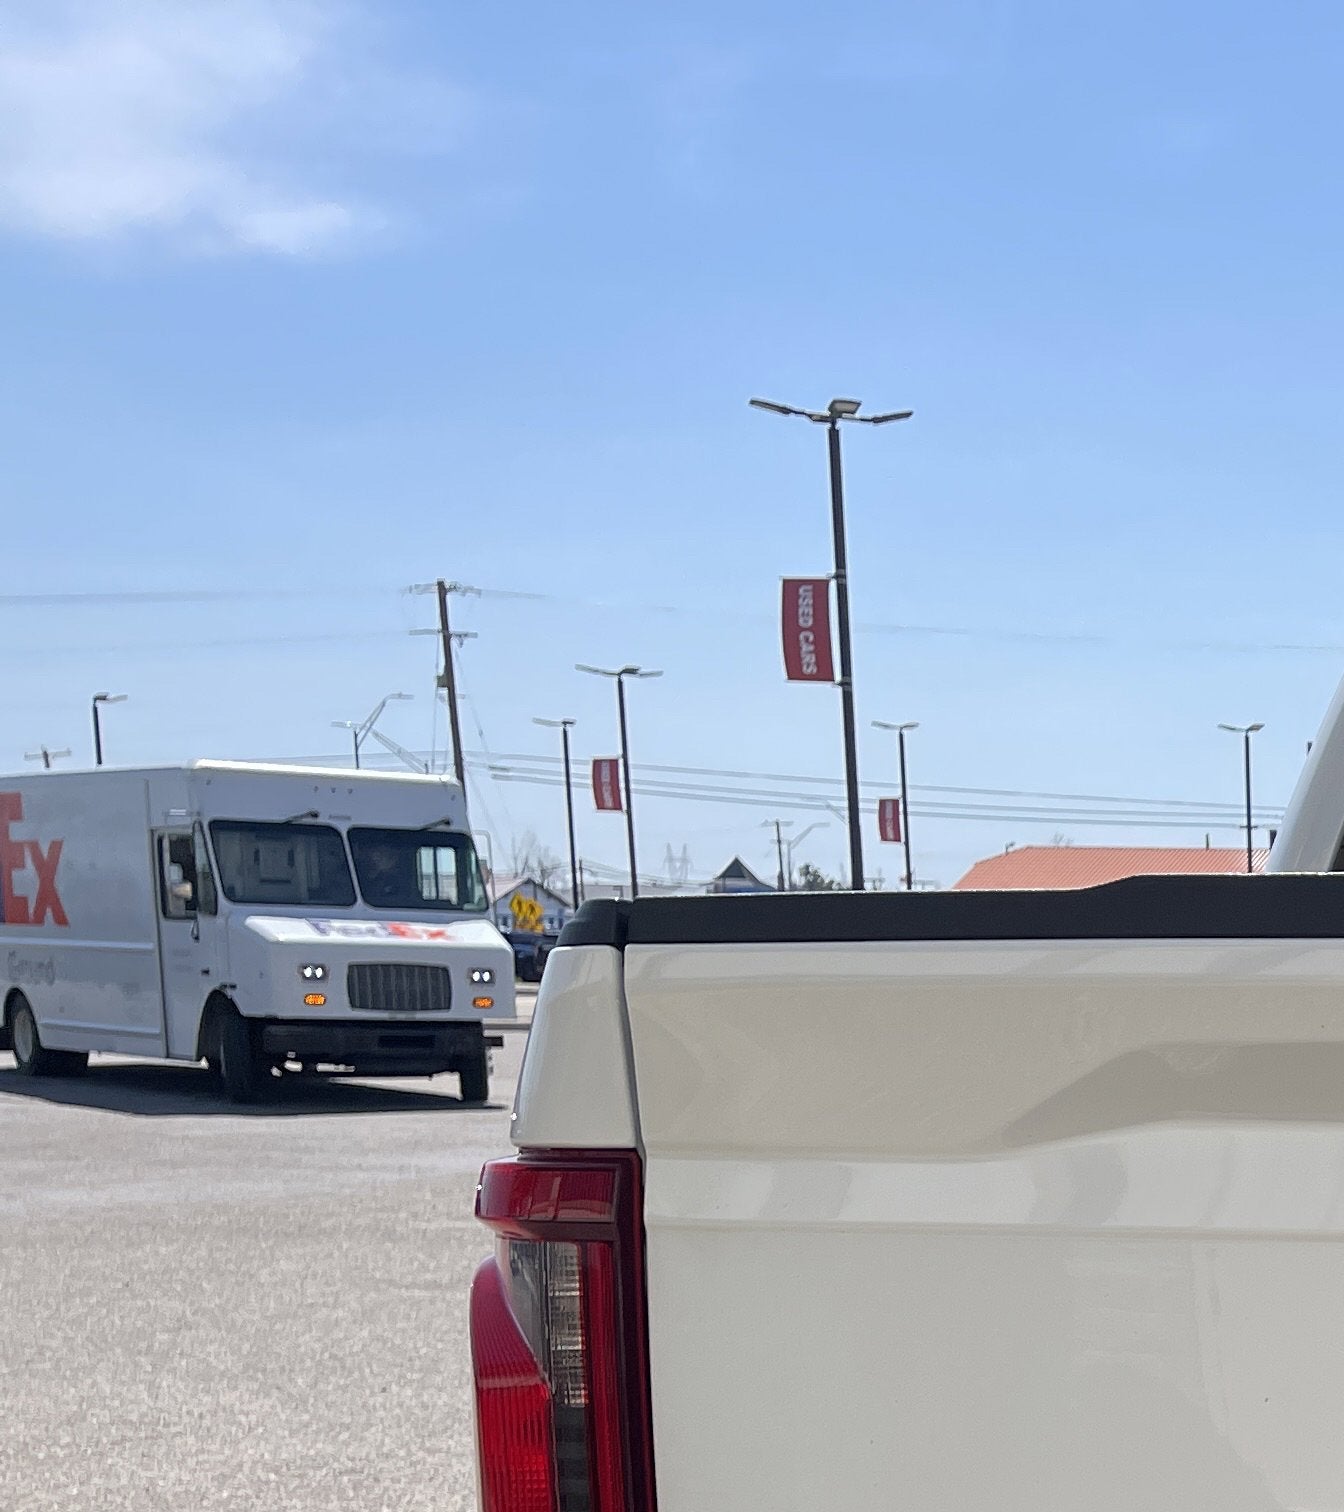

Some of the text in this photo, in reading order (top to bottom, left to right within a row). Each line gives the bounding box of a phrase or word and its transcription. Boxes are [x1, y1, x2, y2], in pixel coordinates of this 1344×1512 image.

[798, 584, 818, 675] USED CARS
[0, 792, 70, 927] Ex
